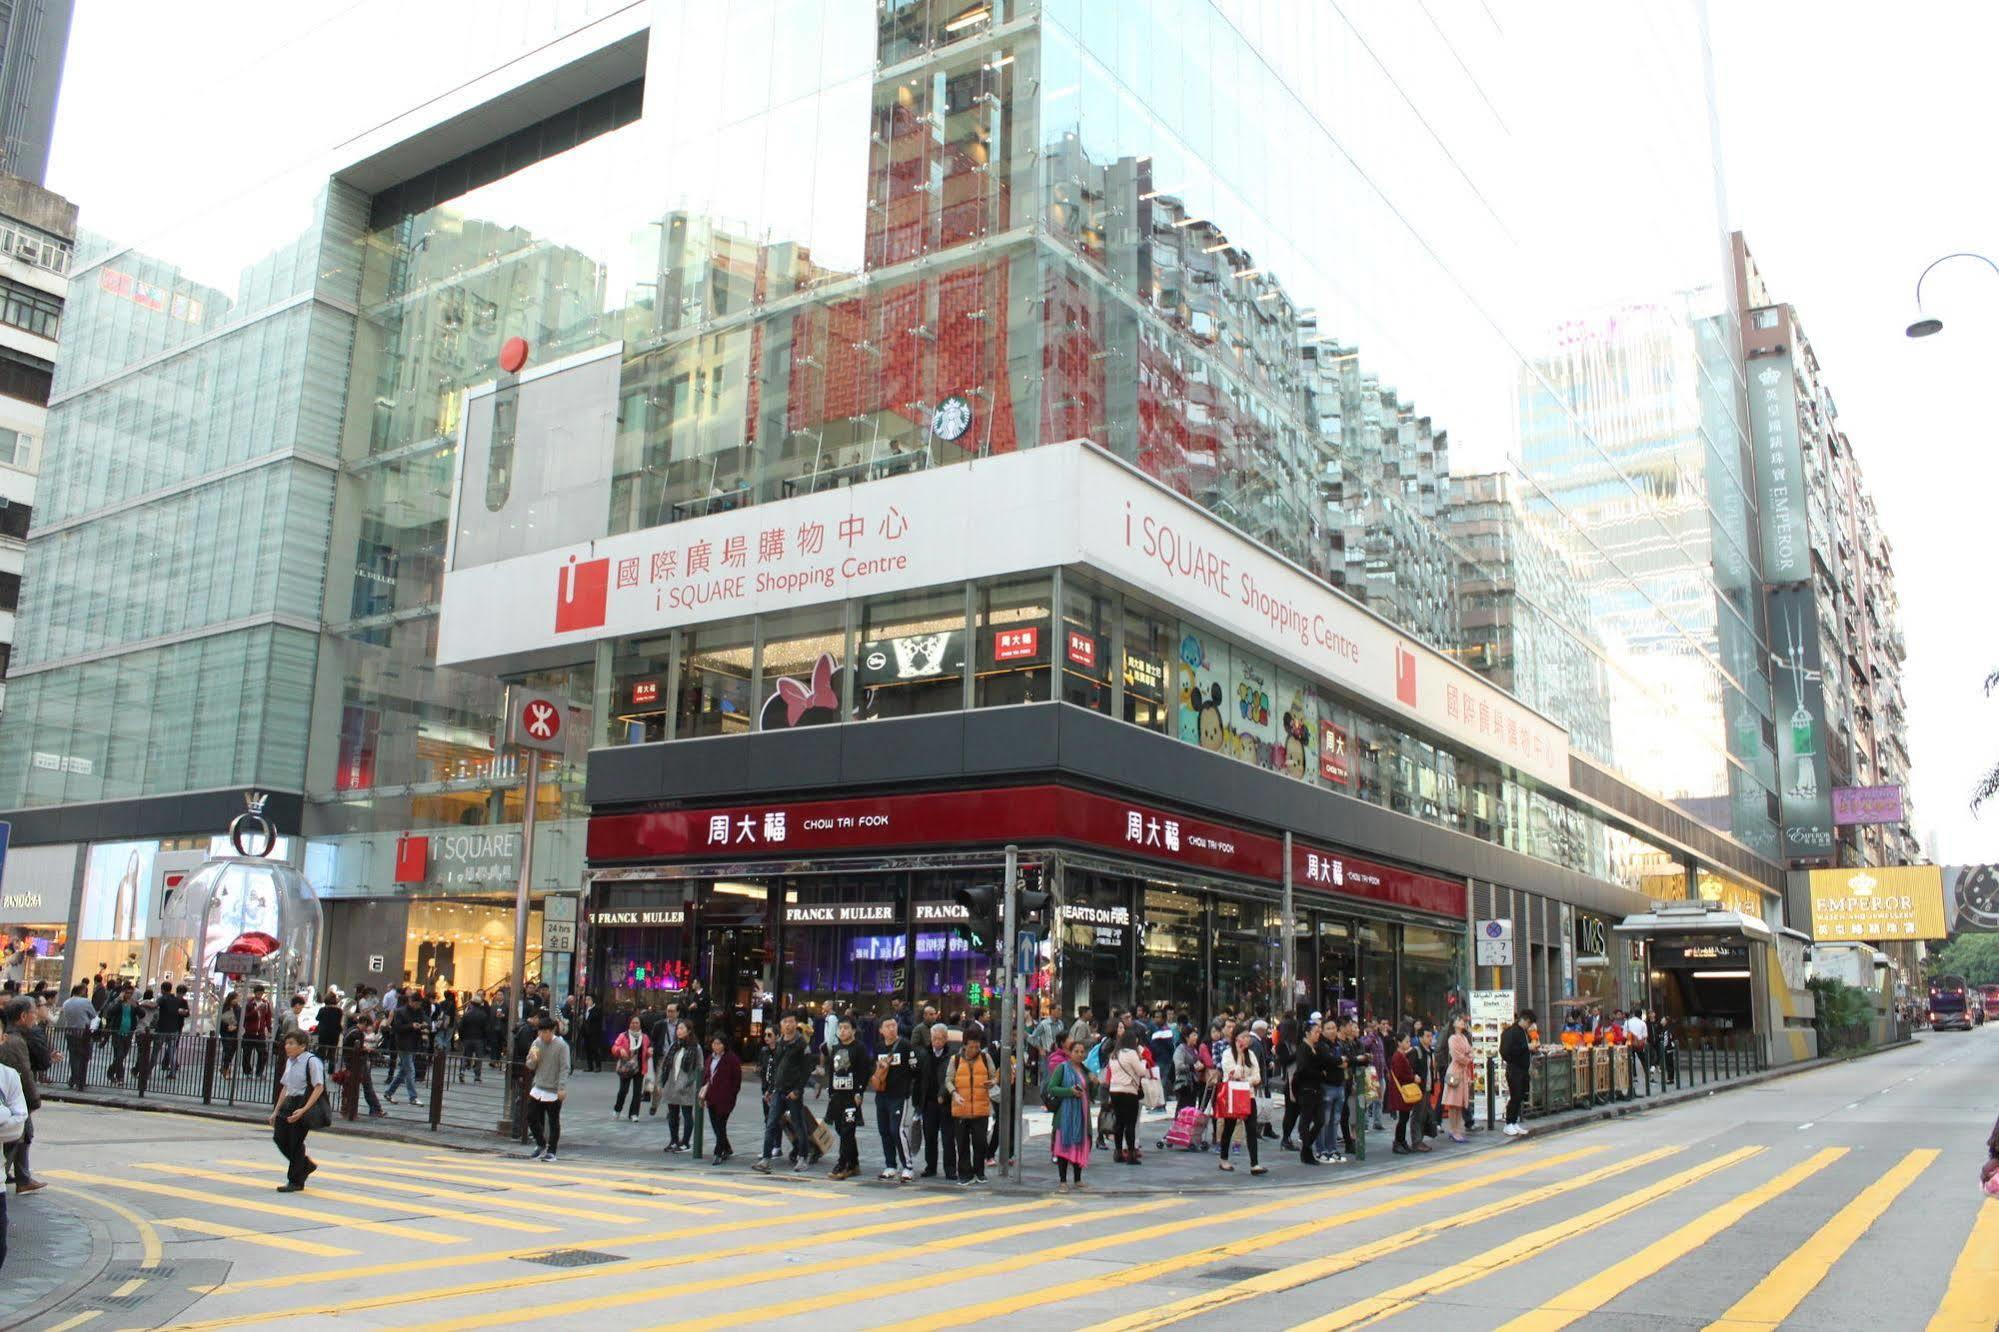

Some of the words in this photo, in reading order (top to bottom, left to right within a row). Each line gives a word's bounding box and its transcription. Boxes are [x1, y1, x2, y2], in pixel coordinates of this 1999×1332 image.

[1773, 486, 1795, 571] EMPEROR
[616, 505, 908, 589] 國際廣場購物中心
[656, 585, 661, 611] i
[669, 576, 746, 610] SQUARE
[756, 565, 835, 593] Shopping
[841, 554, 907, 578] Centre
[1126, 501, 1131, 546] i
[1143, 516, 1231, 598] SQUARE
[1241, 572, 1309, 646] Shopping
[1313, 614, 1359, 663] Centre
[708, 811, 786, 845] 周大福
[803, 818, 833, 830] CHOW
[837, 817, 854, 828] TAI
[858, 815, 889, 827] FOOK
[1125, 811, 1180, 852] 周大福
[444, 834, 514, 863] SQUARE
[1188, 835, 1206, 849] CHOW
[1207, 840, 1217, 850] TAI
[1217, 842, 1235, 854] FOOK
[1307, 853, 1343, 886] 周大福
[915, 904, 970, 918] FRANCK
[1816, 896, 1913, 912] EMPEROR
[598, 911, 638, 924] FRANCK
[642, 911, 685, 923] MULLER
[785, 908, 835, 921] FRANCK
[839, 906, 893, 920] MULLER
[1096, 908, 1110, 923] ON
[1110, 911, 1130, 926] FIRE
[548, 923, 558, 933] 24
[559, 925, 571, 934] hrs
[1582, 914, 1606, 956] M&S
[549, 935, 569, 949] 全日
[1500, 942, 1506, 951] 7
[1501, 955, 1507, 964] 7
